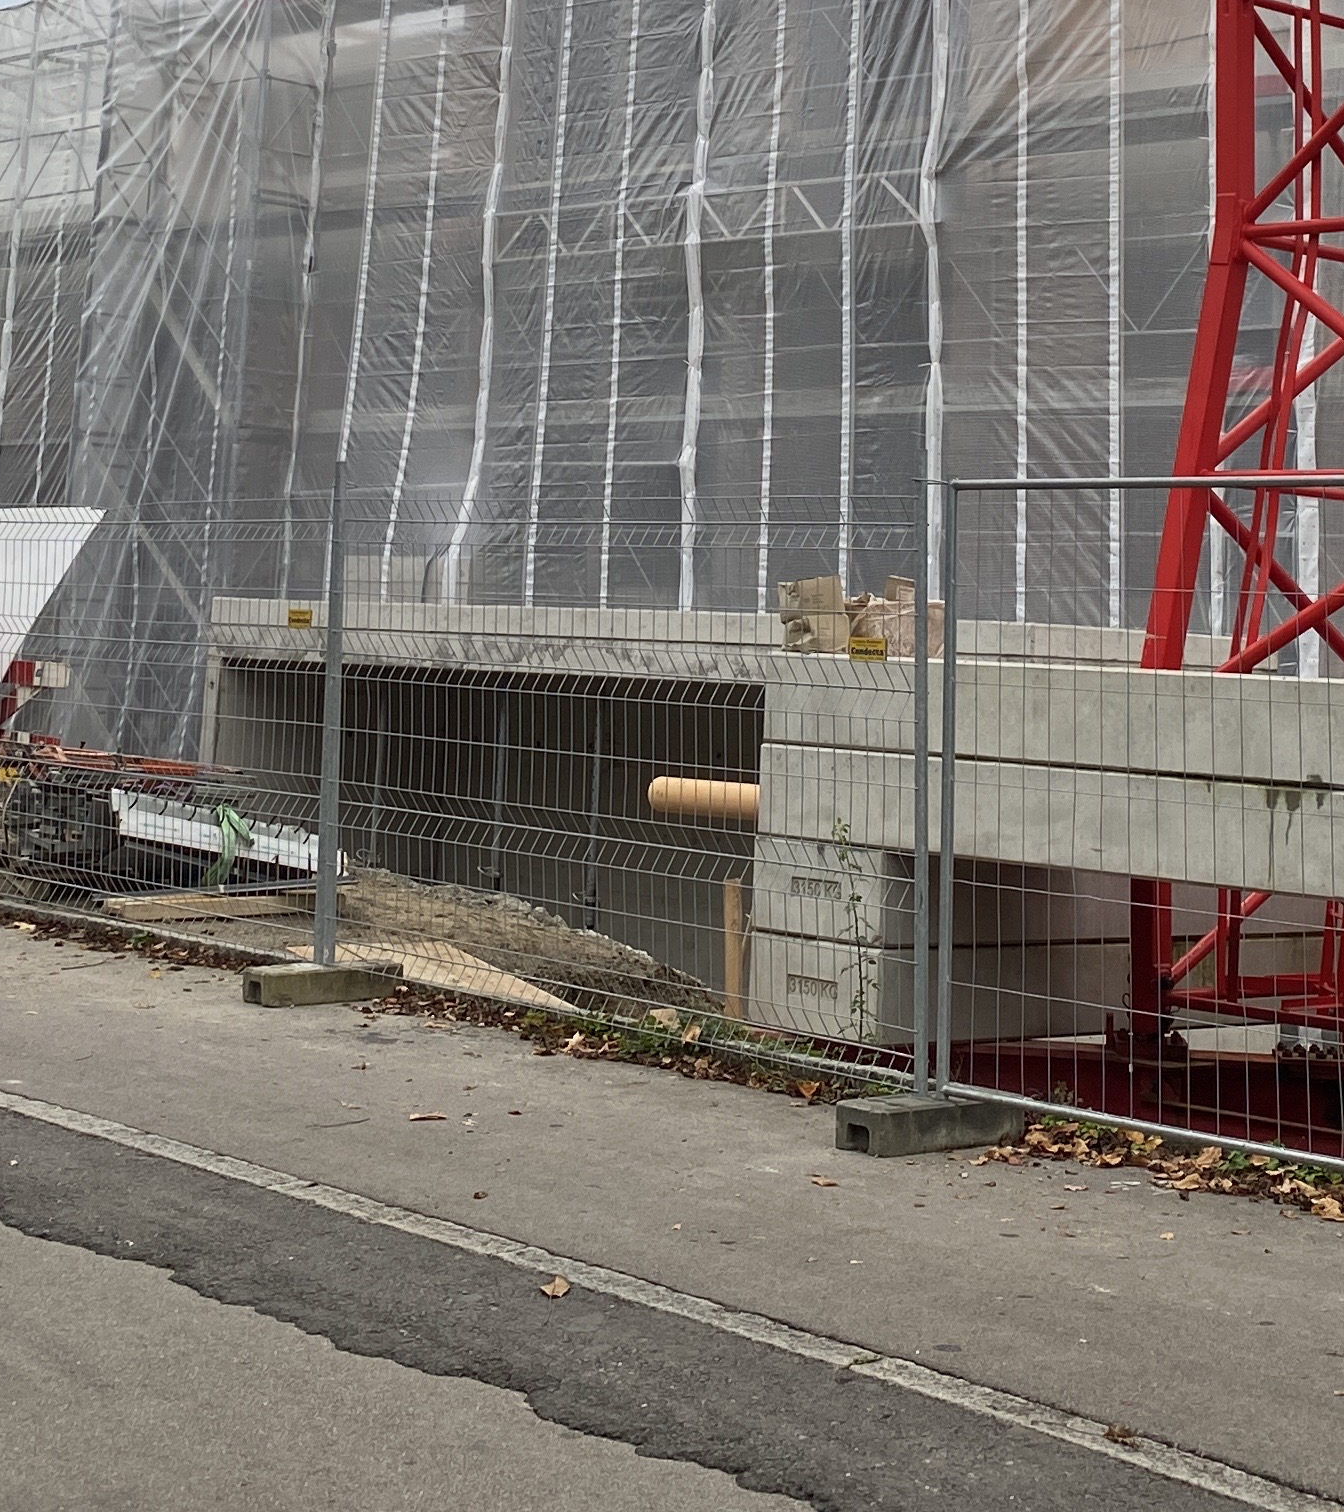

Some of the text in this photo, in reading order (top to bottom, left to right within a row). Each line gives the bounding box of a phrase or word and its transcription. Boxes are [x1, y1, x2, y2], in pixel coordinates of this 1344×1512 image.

[792, 879, 821, 897] 3150
[789, 977, 838, 999] 3150 KG
